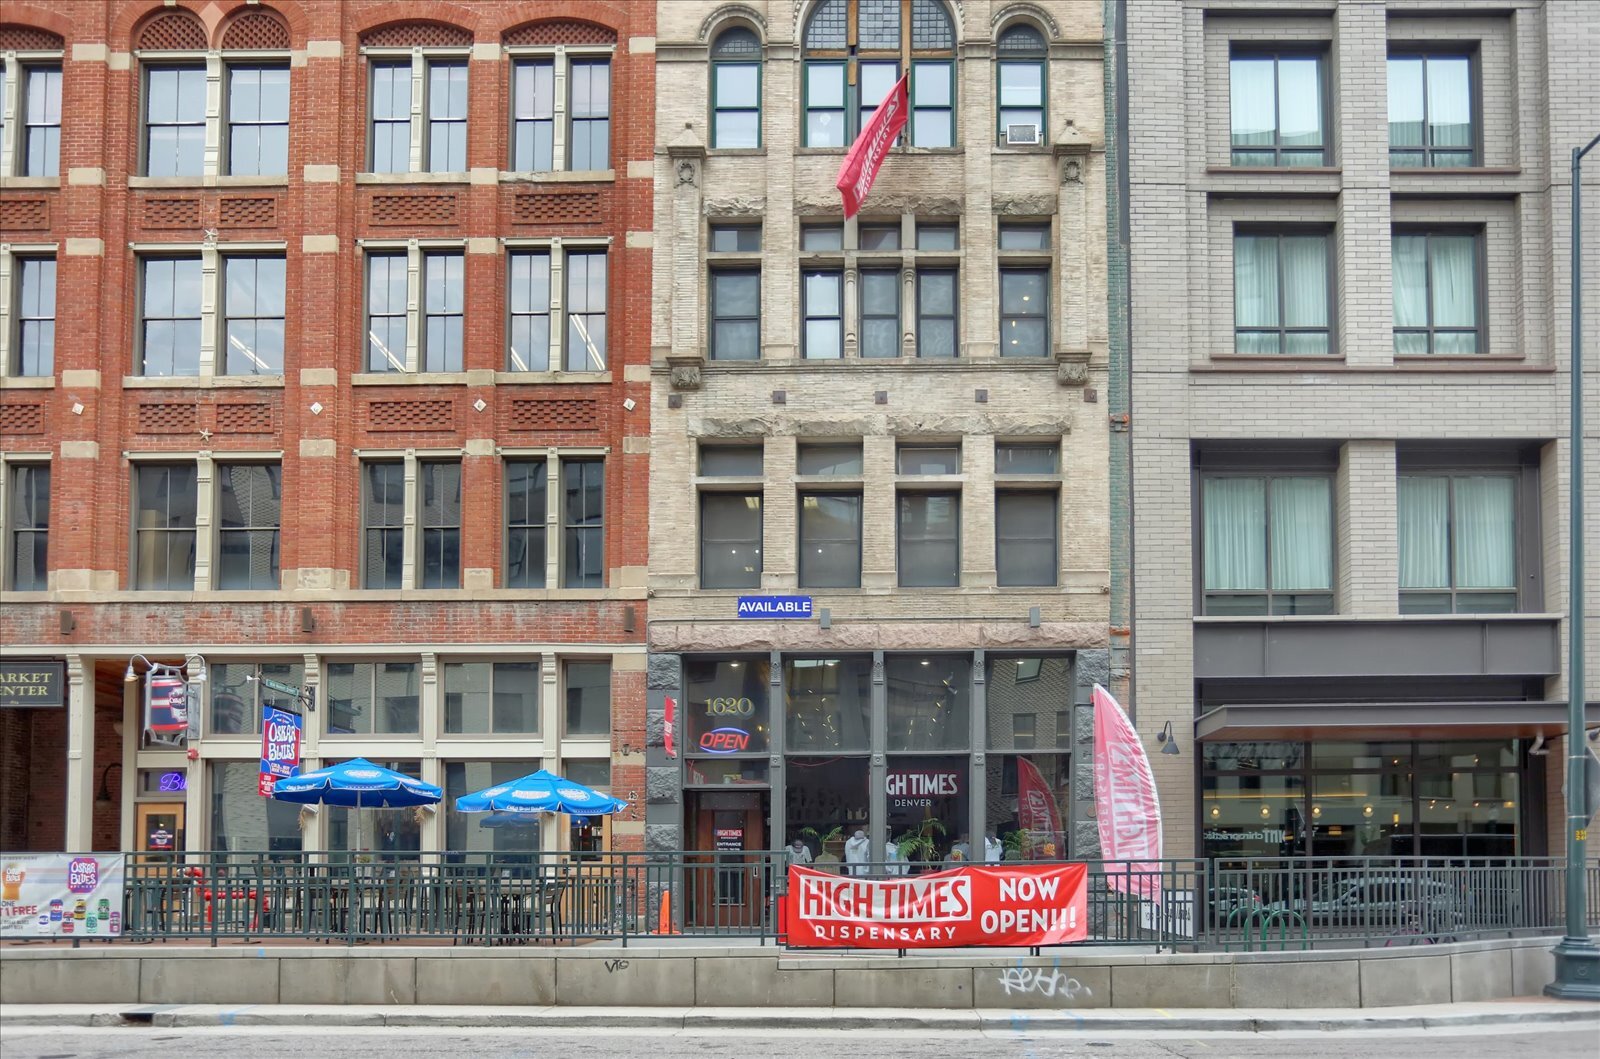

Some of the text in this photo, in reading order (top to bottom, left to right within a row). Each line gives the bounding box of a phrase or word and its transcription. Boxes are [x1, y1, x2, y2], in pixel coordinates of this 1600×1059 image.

[738, 601, 811, 612] AVAILABLE
[0, 672, 53, 683] ARKET
[704, 697, 753, 716] 1620
[699, 732, 750, 750] OPEN
[886, 774, 958, 795] GH TIMES
[894, 799, 932, 807] DENVER
[70, 861, 96, 873] OSKAR
[70, 873, 96, 885] BLUES
[1000, 876, 1060, 902] NOW
[803, 878, 969, 919] HIGH TIMES
[12, 905, 38, 916] FREE
[980, 906, 1077, 934] OPEN!!!
[815, 924, 957, 941] DISPENSARY
